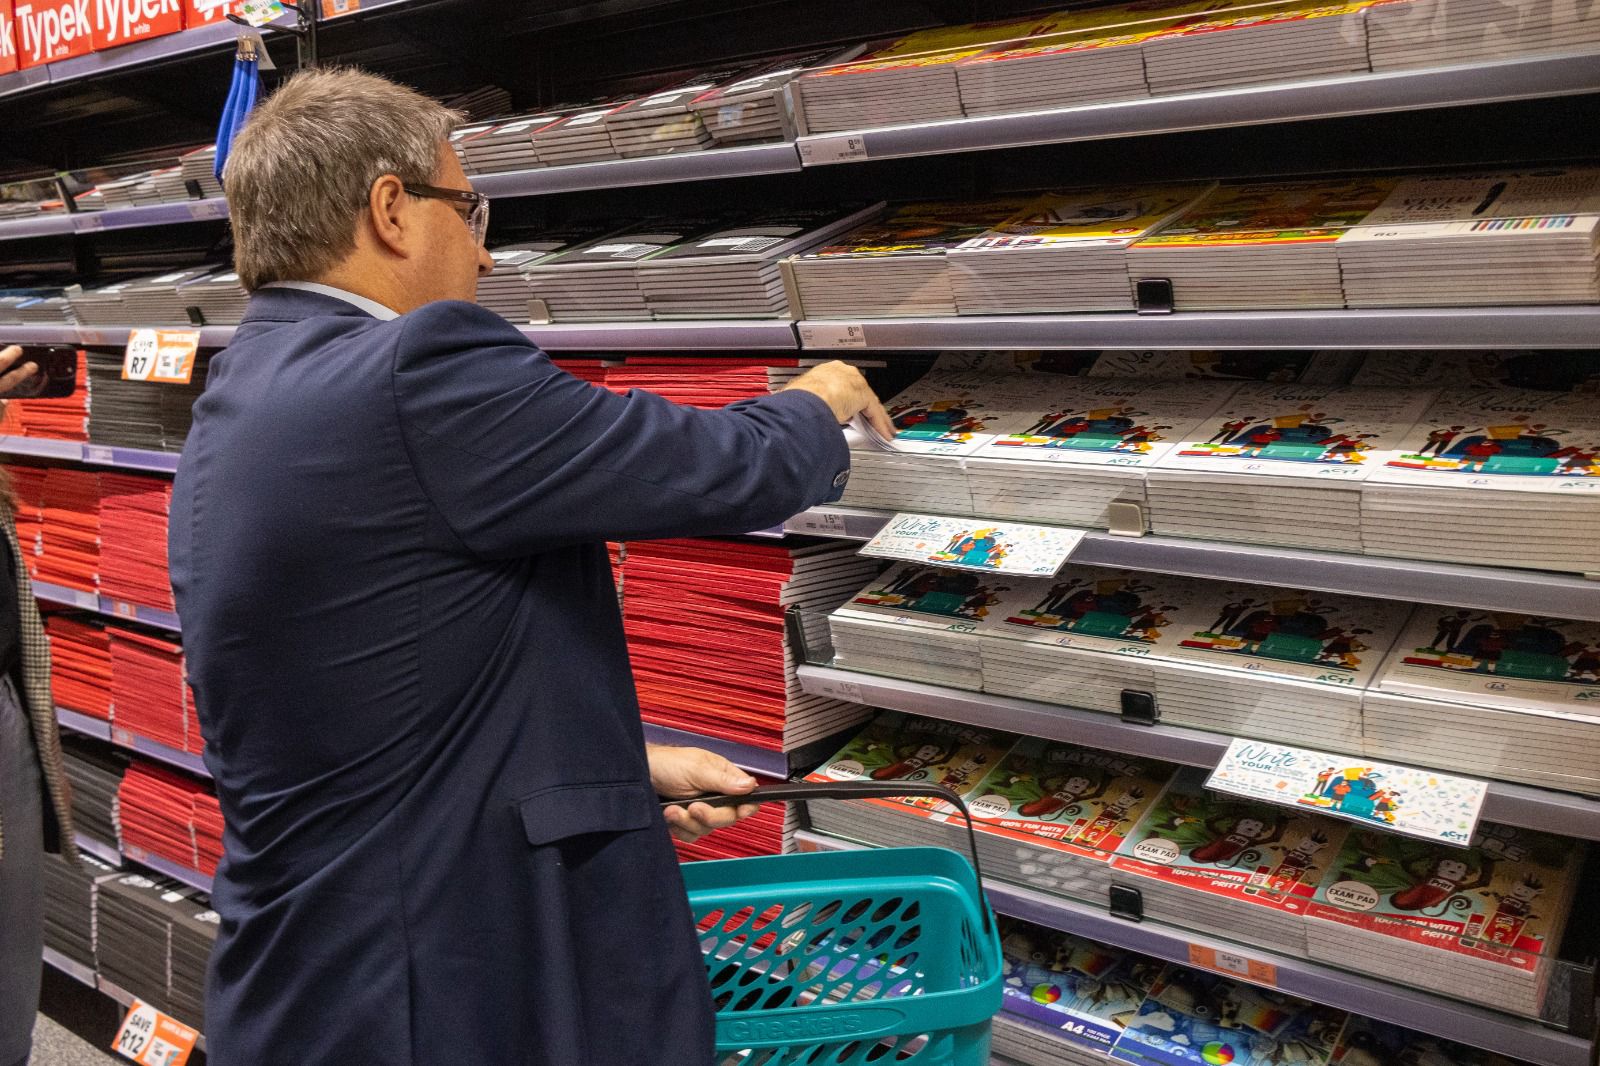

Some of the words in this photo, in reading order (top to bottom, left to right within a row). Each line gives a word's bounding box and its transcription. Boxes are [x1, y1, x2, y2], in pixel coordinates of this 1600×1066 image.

[16, 0, 91, 62] Typek
[130, 357, 147, 374] R7
[1094, 389, 1138, 397] YOUR
[1479, 405, 1537, 413] YOUR
[1106, 457, 1142, 466] ACT!
[892, 518, 942, 534] Write
[946, 624, 976, 633] ACT!
[1117, 647, 1151, 656] ACT!
[1315, 673, 1355, 685] ACT!
[1235, 744, 1298, 767] Write
[1241, 760, 1273, 771] YOUR
[971, 801, 992, 809] EXAM
[1439, 831, 1469, 842] ACT!
[1136, 844, 1159, 854] EXAM
[1159, 850, 1177, 859] PAD
[1211, 881, 1241, 890] PRITT
[1328, 888, 1355, 900] EXAM
[1356, 894, 1376, 904] PAD
[1428, 922, 1460, 933] WITH
[1421, 930, 1457, 941] PRITT
[129, 1013, 152, 1033] SAVE
[1060, 1021, 1085, 1035] A4
[119, 1029, 145, 1055] R12
